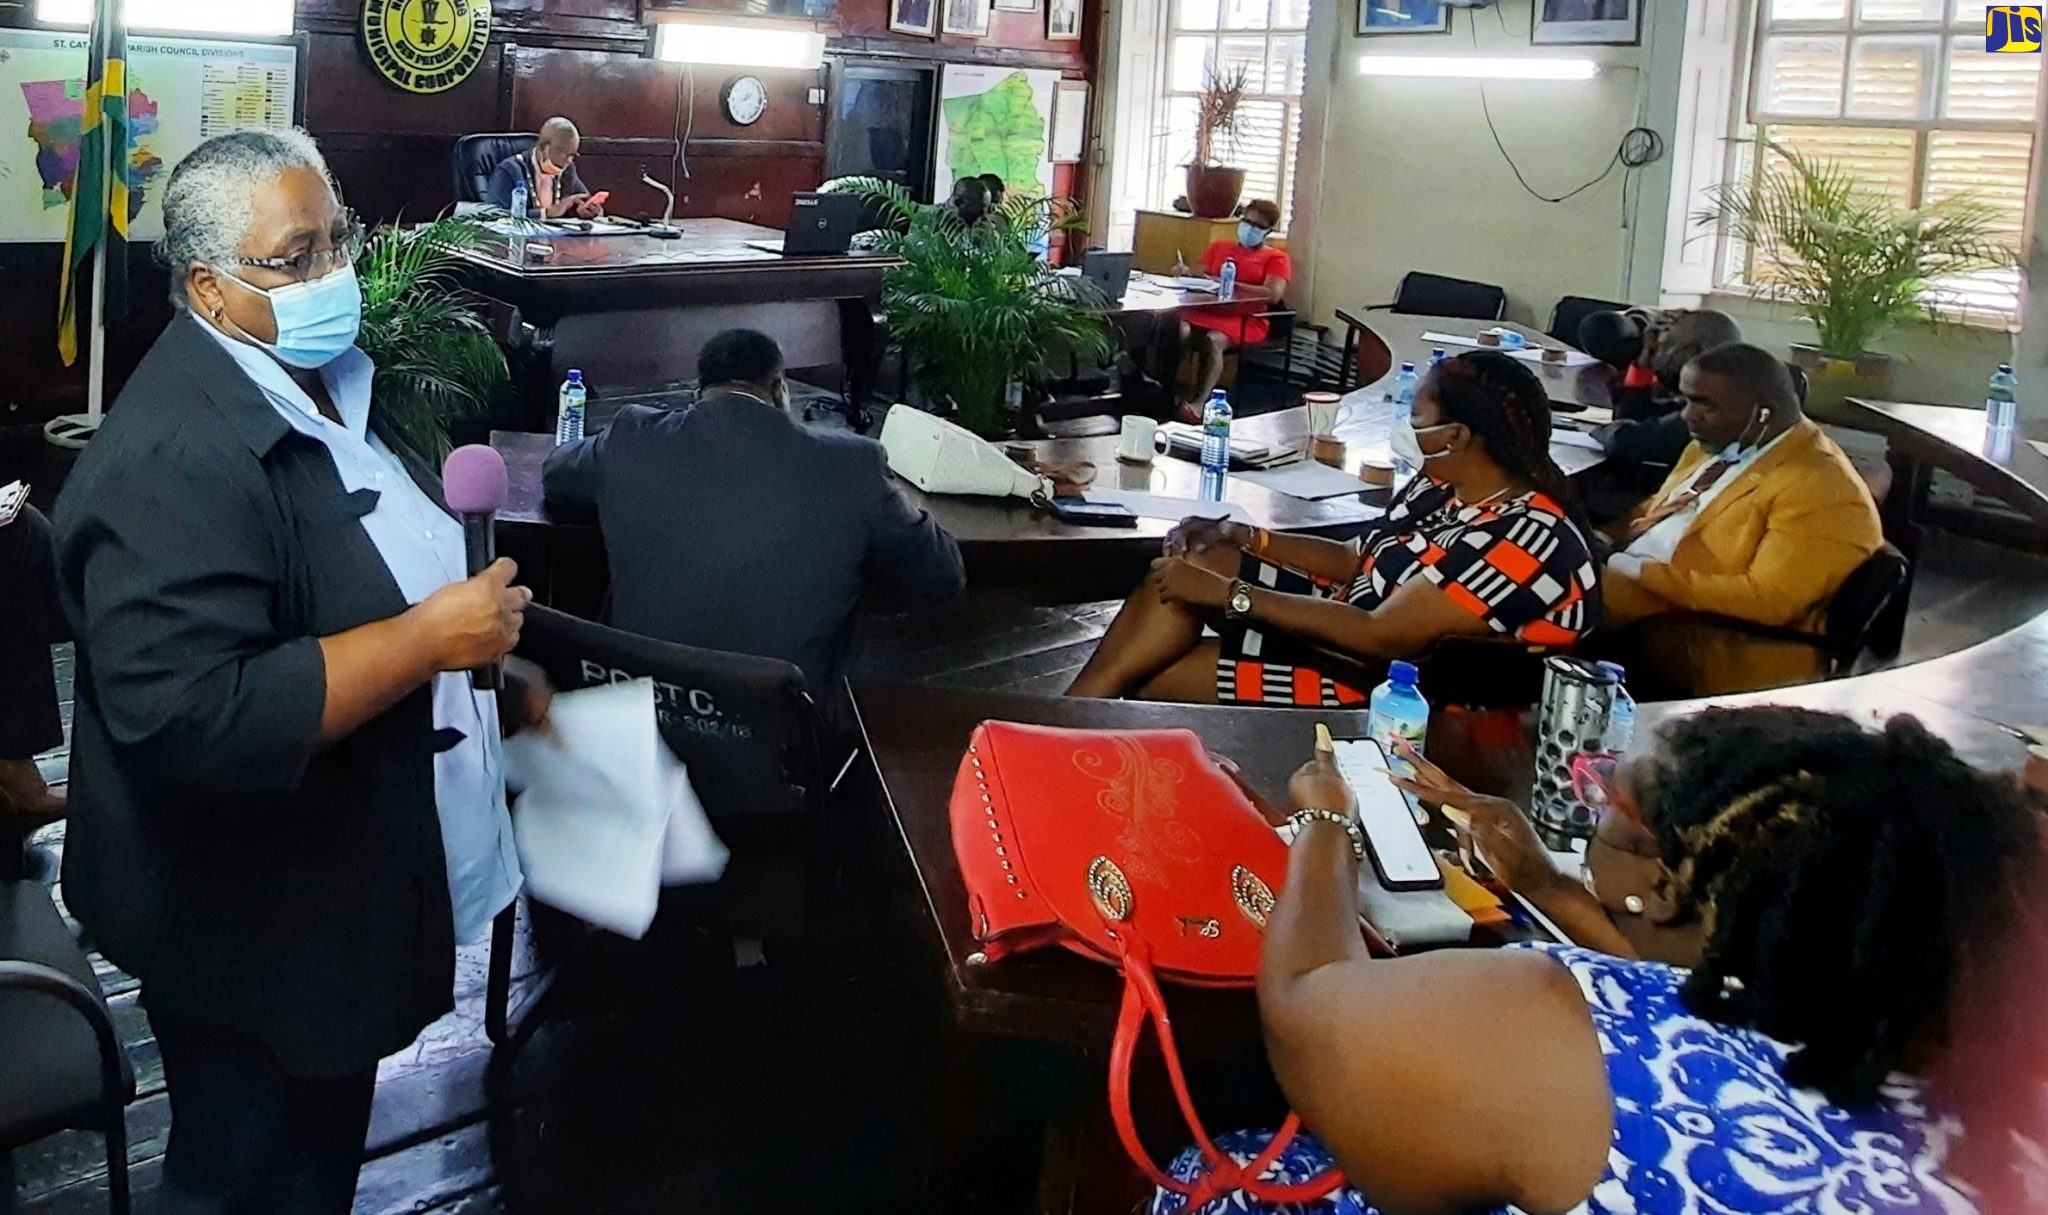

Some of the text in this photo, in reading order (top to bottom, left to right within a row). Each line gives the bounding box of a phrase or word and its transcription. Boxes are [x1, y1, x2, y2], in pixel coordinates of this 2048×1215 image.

[53, 39, 67, 48] ST.
[160, 46, 200, 56] COUNCIL
[201, 48, 244, 58] DIVISIONS
[415, 7, 489, 89] CORPORATION
